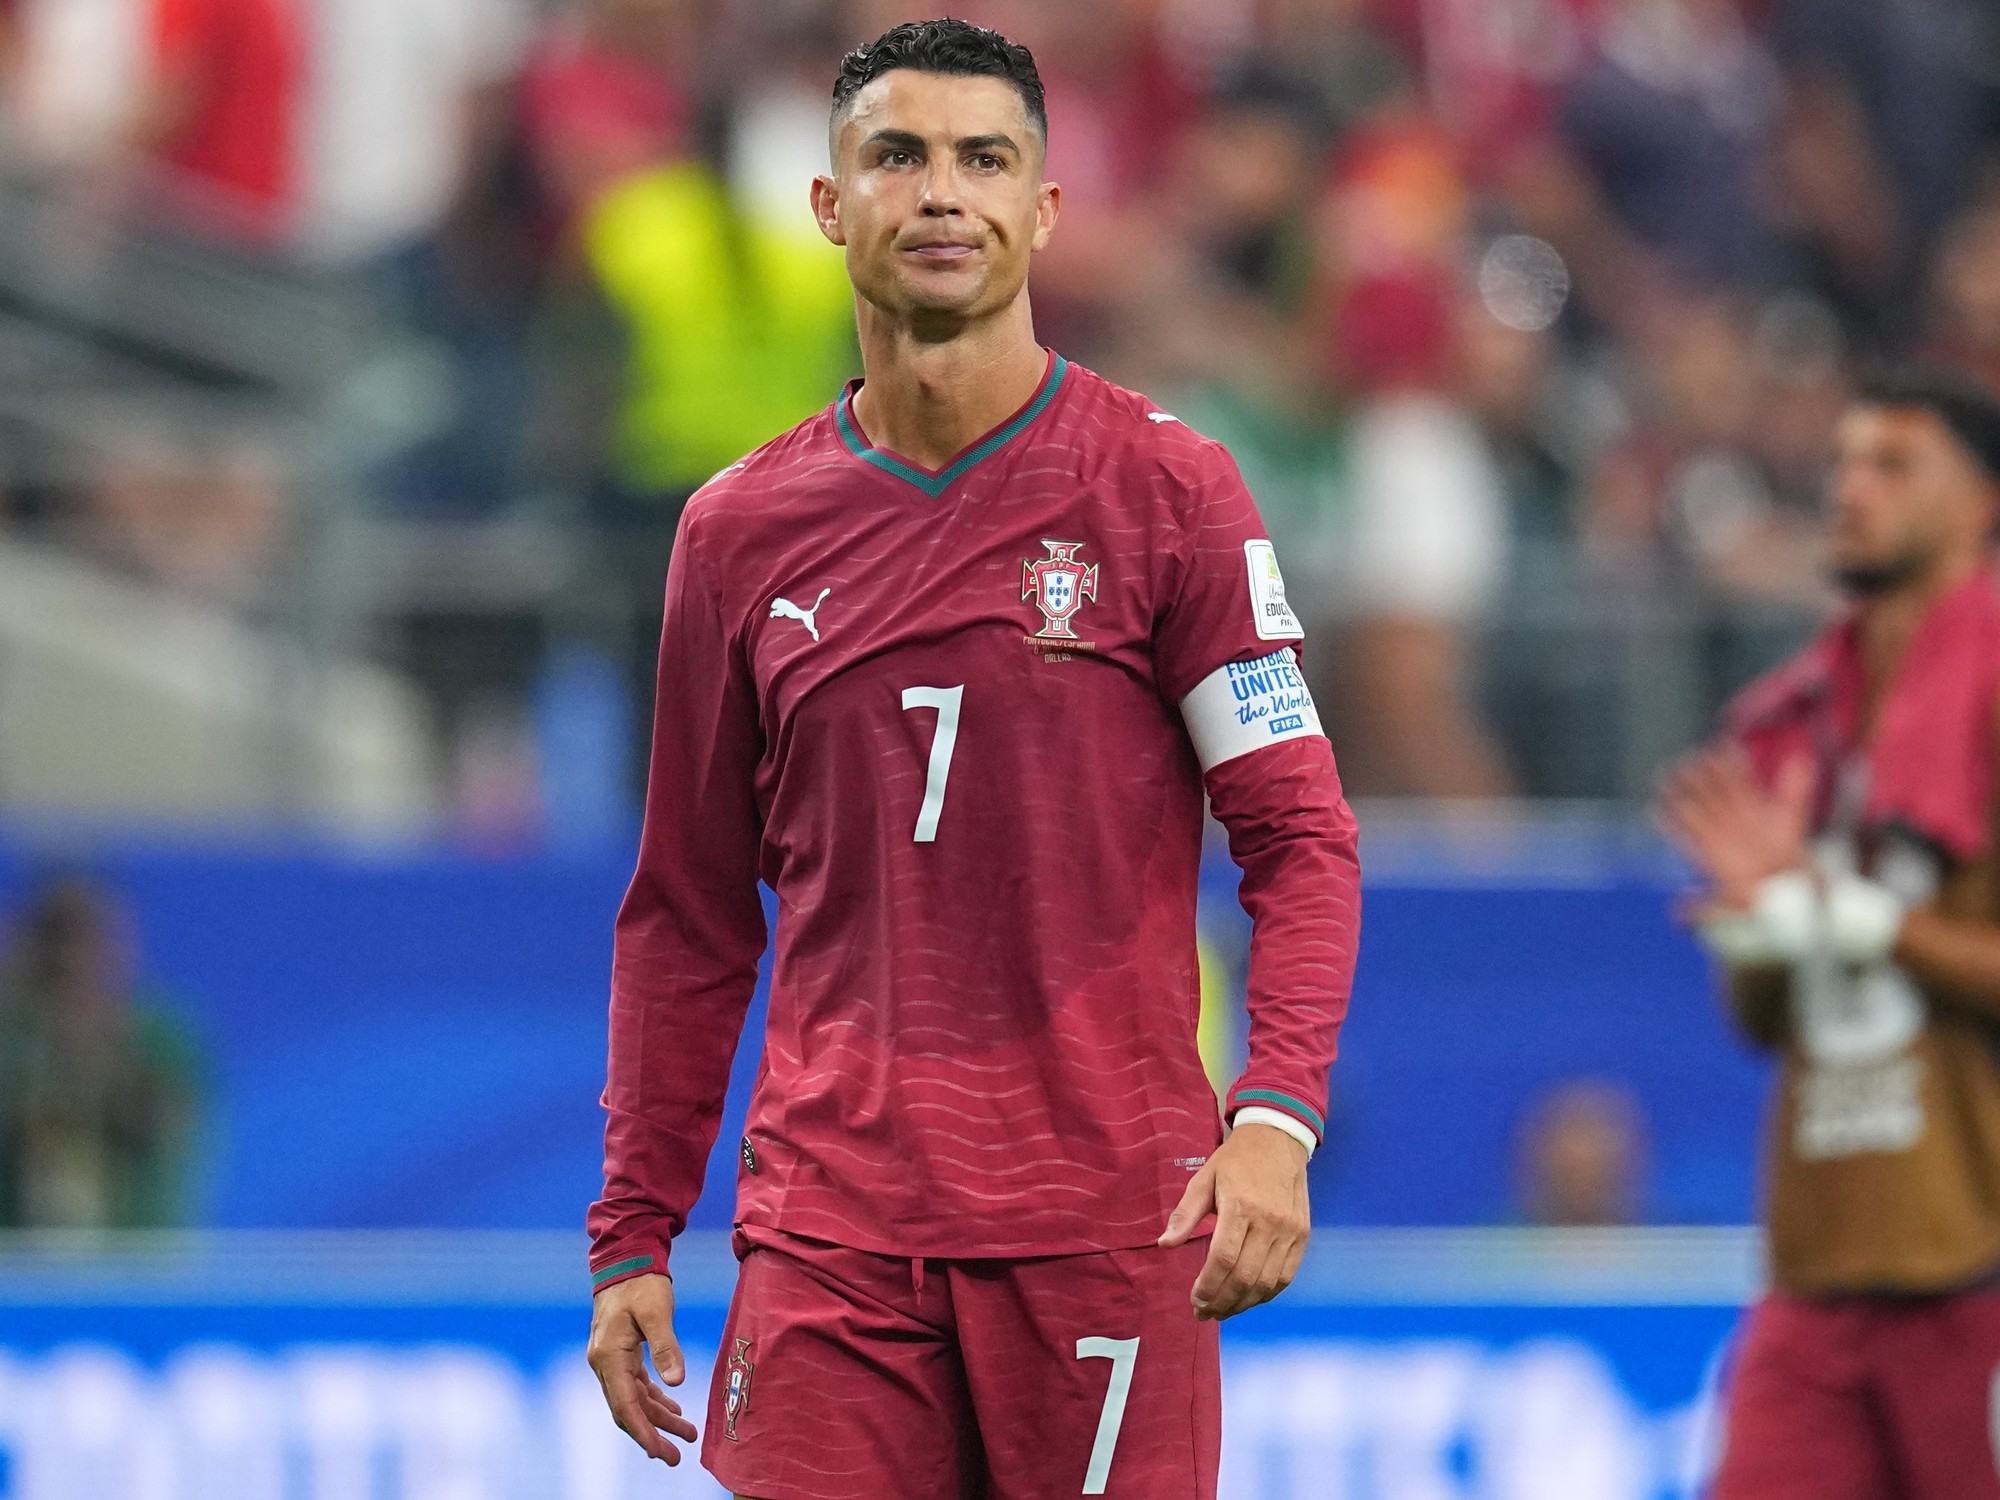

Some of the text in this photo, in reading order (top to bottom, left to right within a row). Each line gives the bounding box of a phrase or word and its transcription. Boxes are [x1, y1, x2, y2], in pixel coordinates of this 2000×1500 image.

[1044, 653, 1072, 663] DALLAS
[1226, 649, 1294, 678] FOOTBALL
[1231, 666, 1304, 702] UNITES
[1234, 689, 1312, 725] the World
[1271, 716, 1302, 733] FIFA
[901, 683, 965, 842] 7
[1076, 1336, 1140, 1495] 7
